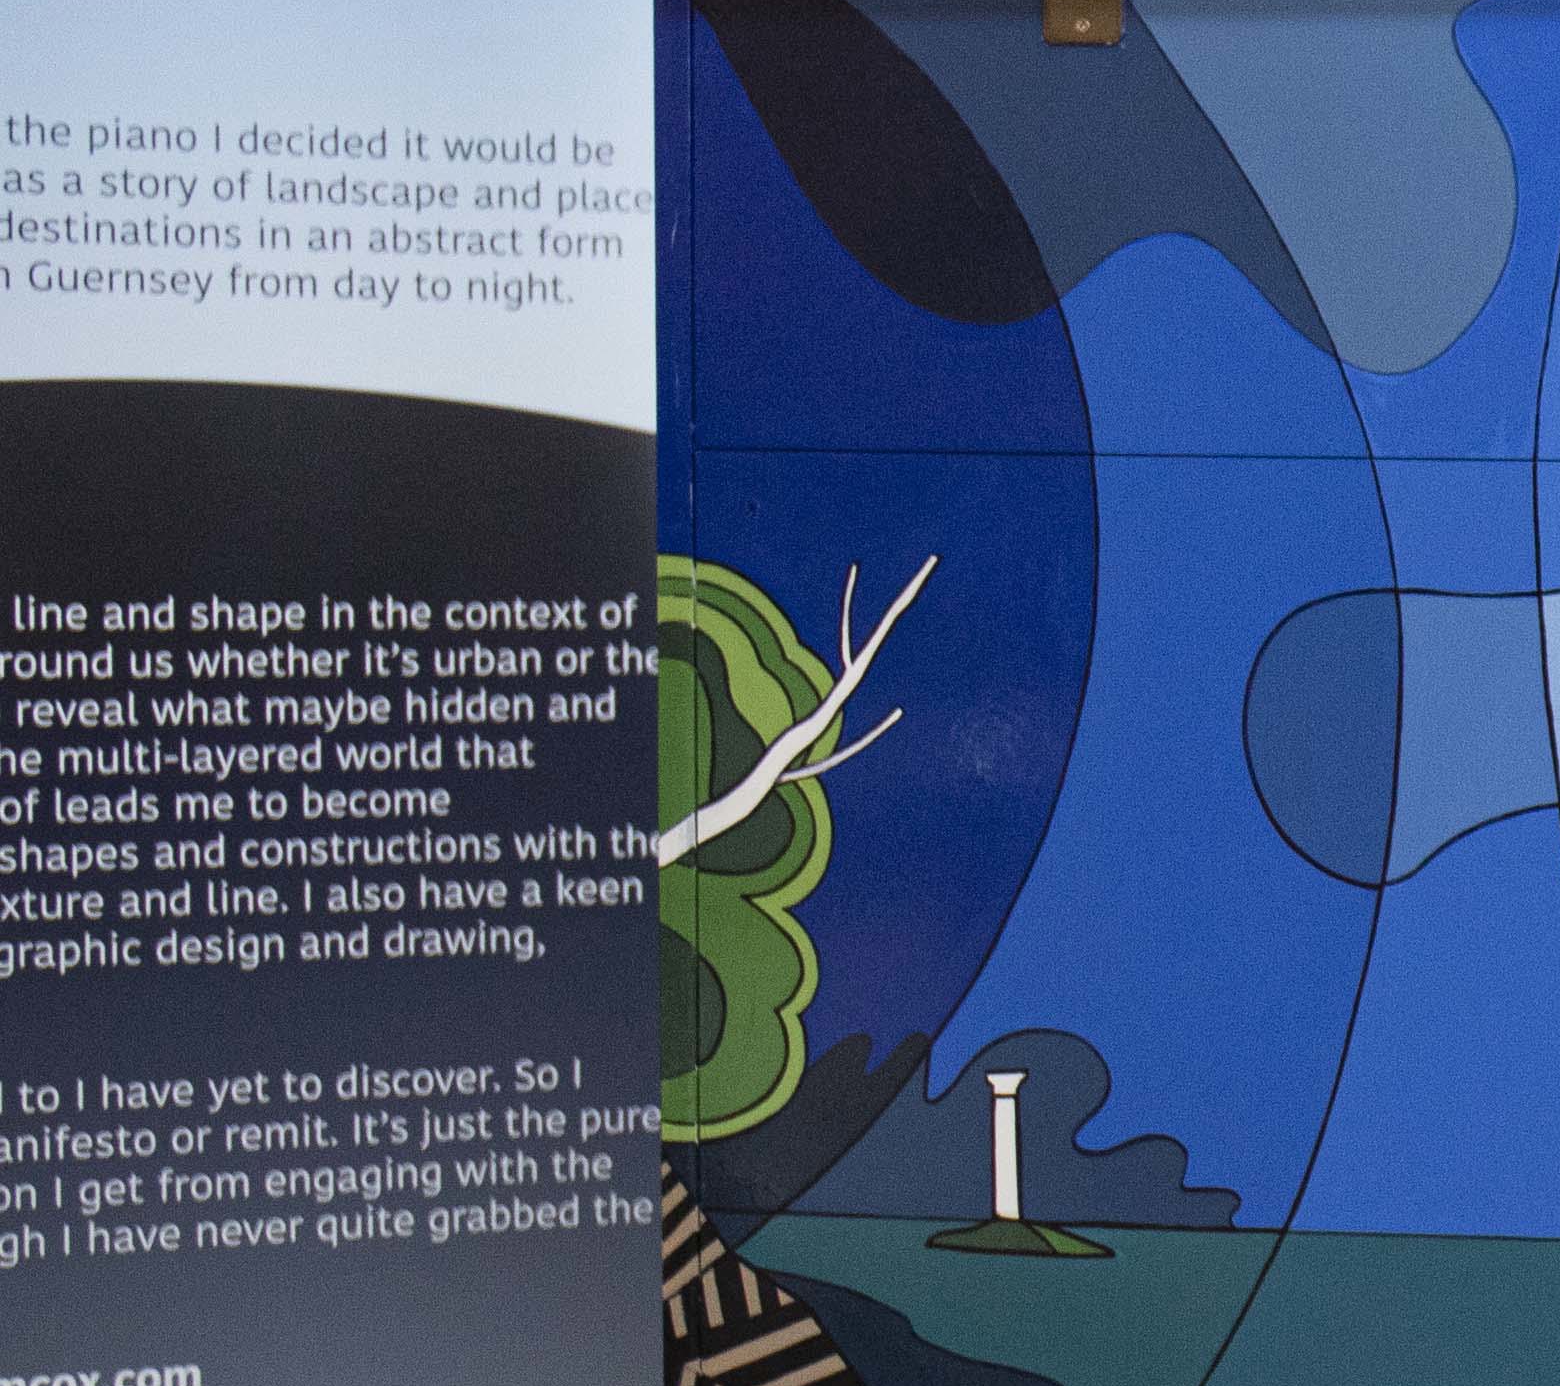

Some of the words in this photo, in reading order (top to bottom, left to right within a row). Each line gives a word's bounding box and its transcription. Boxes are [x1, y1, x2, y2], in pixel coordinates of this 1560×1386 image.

[7, 114, 71, 147] the
[89, 117, 198, 156] piano
[213, 123, 222, 152] I
[238, 122, 387, 160] decided
[404, 127, 430, 161] it
[444, 131, 556, 164] would
[573, 134, 614, 166] be
[3, 168, 46, 195] as
[63, 169, 83, 196] a
[100, 167, 197, 207] story
[213, 169, 251, 202] of
[267, 171, 459, 213] landscape
[474, 179, 541, 210] and
[259, 217, 291, 250] in
[308, 225, 351, 252] an
[369, 222, 523, 257] abstract
[539, 225, 623, 259] form
[29, 261, 213, 304] Guernsey
[229, 264, 318, 298] from
[335, 268, 400, 309] day
[416, 271, 451, 300] to
[468, 271, 574, 313] night.
[13, 593, 88, 632] line
[103, 593, 174, 631] and
[190, 593, 306, 638] shape
[321, 593, 355, 630] in
[369, 593, 432, 630] the
[445, 595, 588, 630] context
[600, 592, 638, 630] of
[129, 649, 174, 679] us
[187, 641, 350, 678] whether
[364, 641, 420, 677] it's
[434, 639, 542, 677] urban
[555, 645, 594, 676] or
[16, 689, 139, 728] reveal
[151, 689, 250, 727] what
[265, 688, 392, 732] maybe
[405, 686, 535, 724] hidden
[550, 686, 616, 723] and
[58, 735, 322, 782] multi-layered
[336, 734, 443, 771] world
[455, 733, 536, 770] that
[0, 787, 41, 825] of
[54, 785, 160, 825] leads
[175, 791, 235, 822] me
[249, 788, 288, 821] to
[302, 783, 451, 818] become
[0, 835, 139, 879] shapes
[154, 831, 225, 870] and
[240, 827, 501, 867] constructions
[513, 824, 596, 861] with
[120, 880, 191, 918] and
[207, 878, 288, 916] line.
[303, 878, 313, 912] I
[327, 875, 405, 912] also
[419, 873, 508, 910] have
[521, 878, 542, 907] a
[556, 870, 643, 907] keen
[0, 930, 142, 979] graphic
[156, 926, 285, 971] design
[300, 923, 369, 961] and
[19, 1081, 60, 1113] to
[76, 1078, 85, 1111] I
[102, 1074, 195, 1110] have
[208, 1071, 270, 1113] yet
[283, 1069, 323, 1103] to
[335, 1063, 501, 1100] discover.
[514, 1057, 560, 1093] So
[573, 1056, 582, 1090] I
[171, 1125, 212, 1156] or
[225, 1114, 339, 1153] remit.
[353, 1110, 408, 1146] It's
[420, 1107, 493, 1151] just
[505, 1103, 567, 1139] the
[580, 1103, 662, 1143] pure
[54, 1176, 63, 1209] I
[79, 1173, 144, 1215] get
[158, 1166, 250, 1204] from
[265, 1156, 441, 1202] engaging
[456, 1149, 538, 1187] with
[552, 1147, 614, 1183] the
[62, 1222, 71, 1256] I
[88, 1220, 181, 1256] have
[197, 1214, 304, 1248] never
[316, 1205, 415, 1248] quite
[428, 1192, 580, 1244] grabbed
[593, 1192, 654, 1227] the
